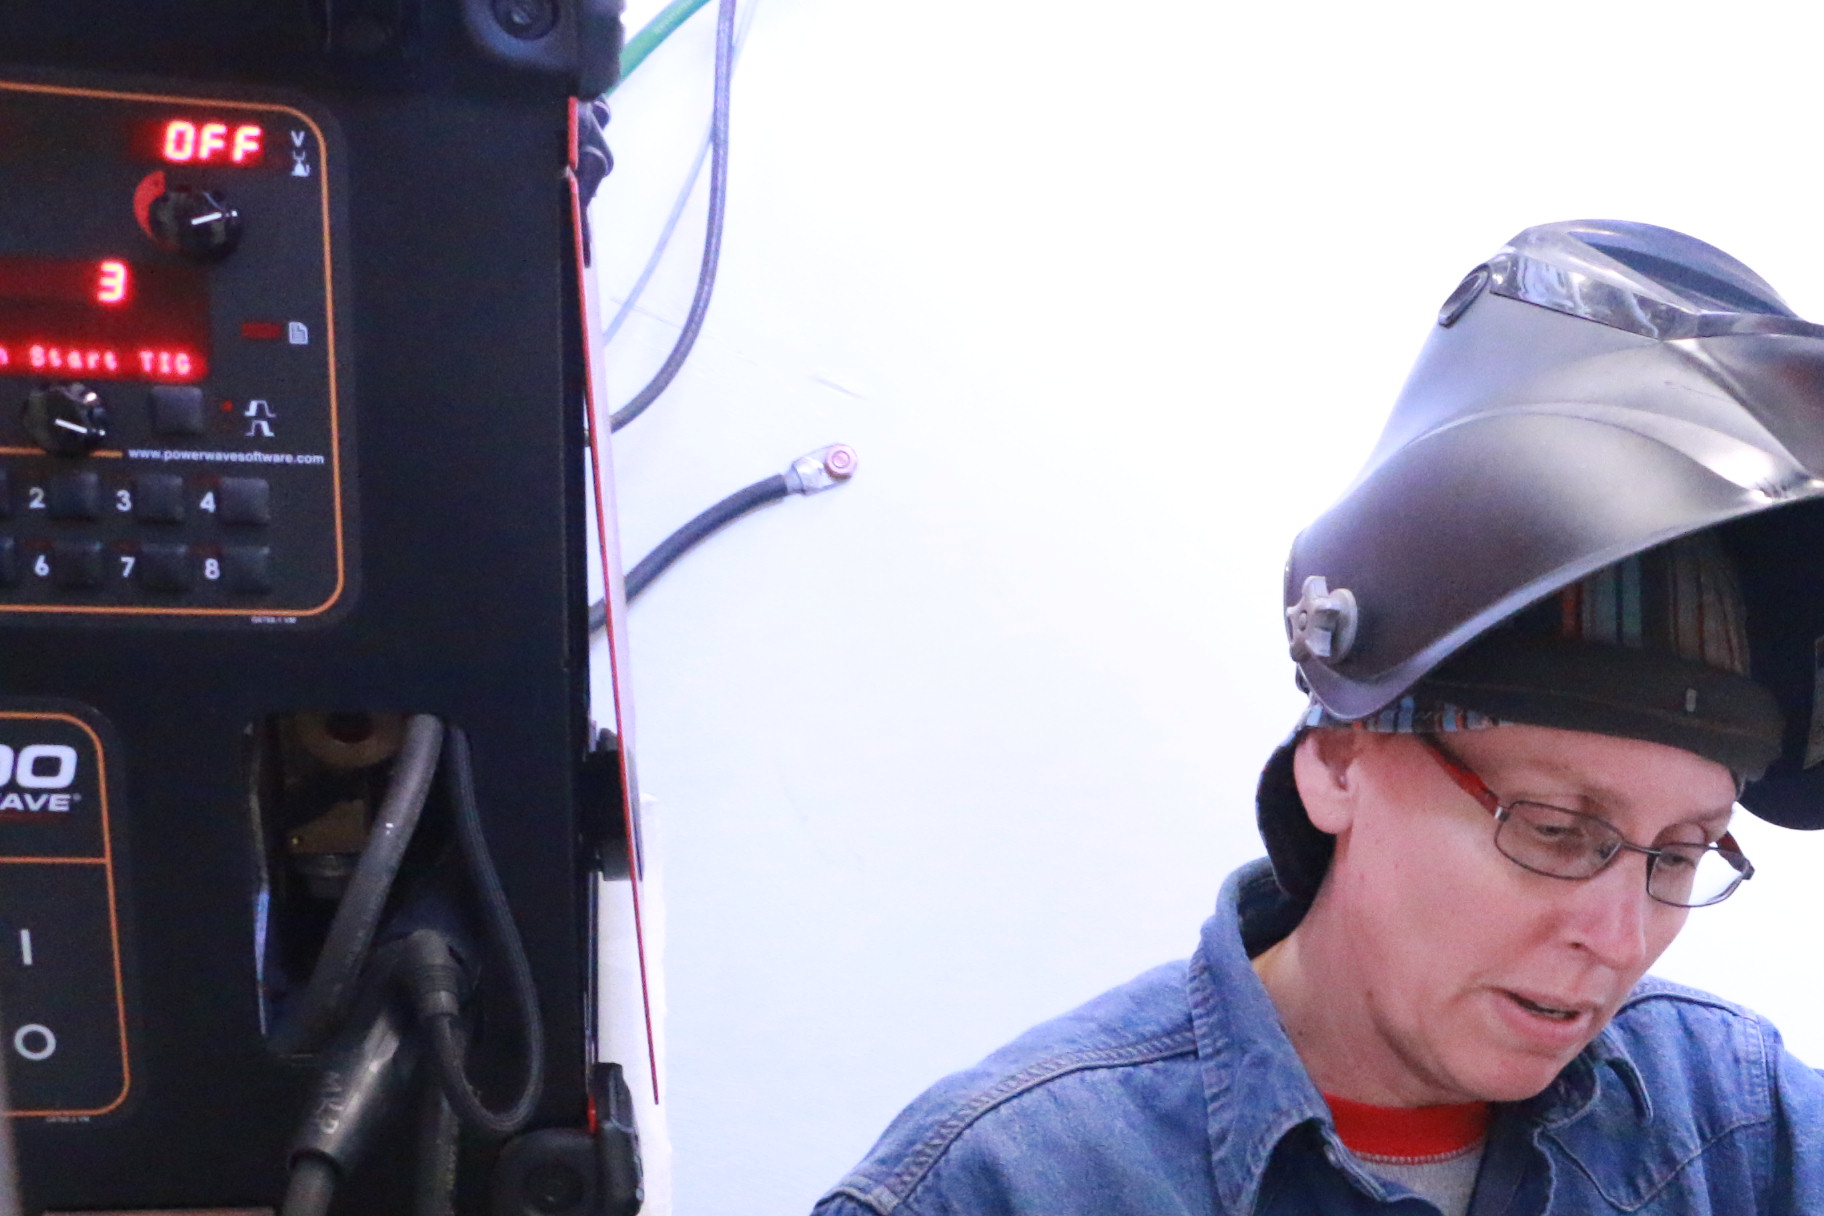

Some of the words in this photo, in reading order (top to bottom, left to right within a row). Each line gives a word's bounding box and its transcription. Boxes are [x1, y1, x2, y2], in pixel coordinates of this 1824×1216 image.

[164, 120, 262, 163] OFF
[290, 130, 305, 147] V
[98, 260, 127, 302] 3
[29, 344, 118, 371] Start
[140, 350, 192, 375] TIG
[128, 448, 325, 465] www.powerwavesoftware.com
[29, 487, 46, 509] 2
[116, 490, 132, 511] 3
[200, 491, 216, 513] 4
[34, 555, 50, 576] 6
[120, 556, 136, 577] 7
[204, 558, 220, 580] 8
[0, 793, 70, 812] AVE
